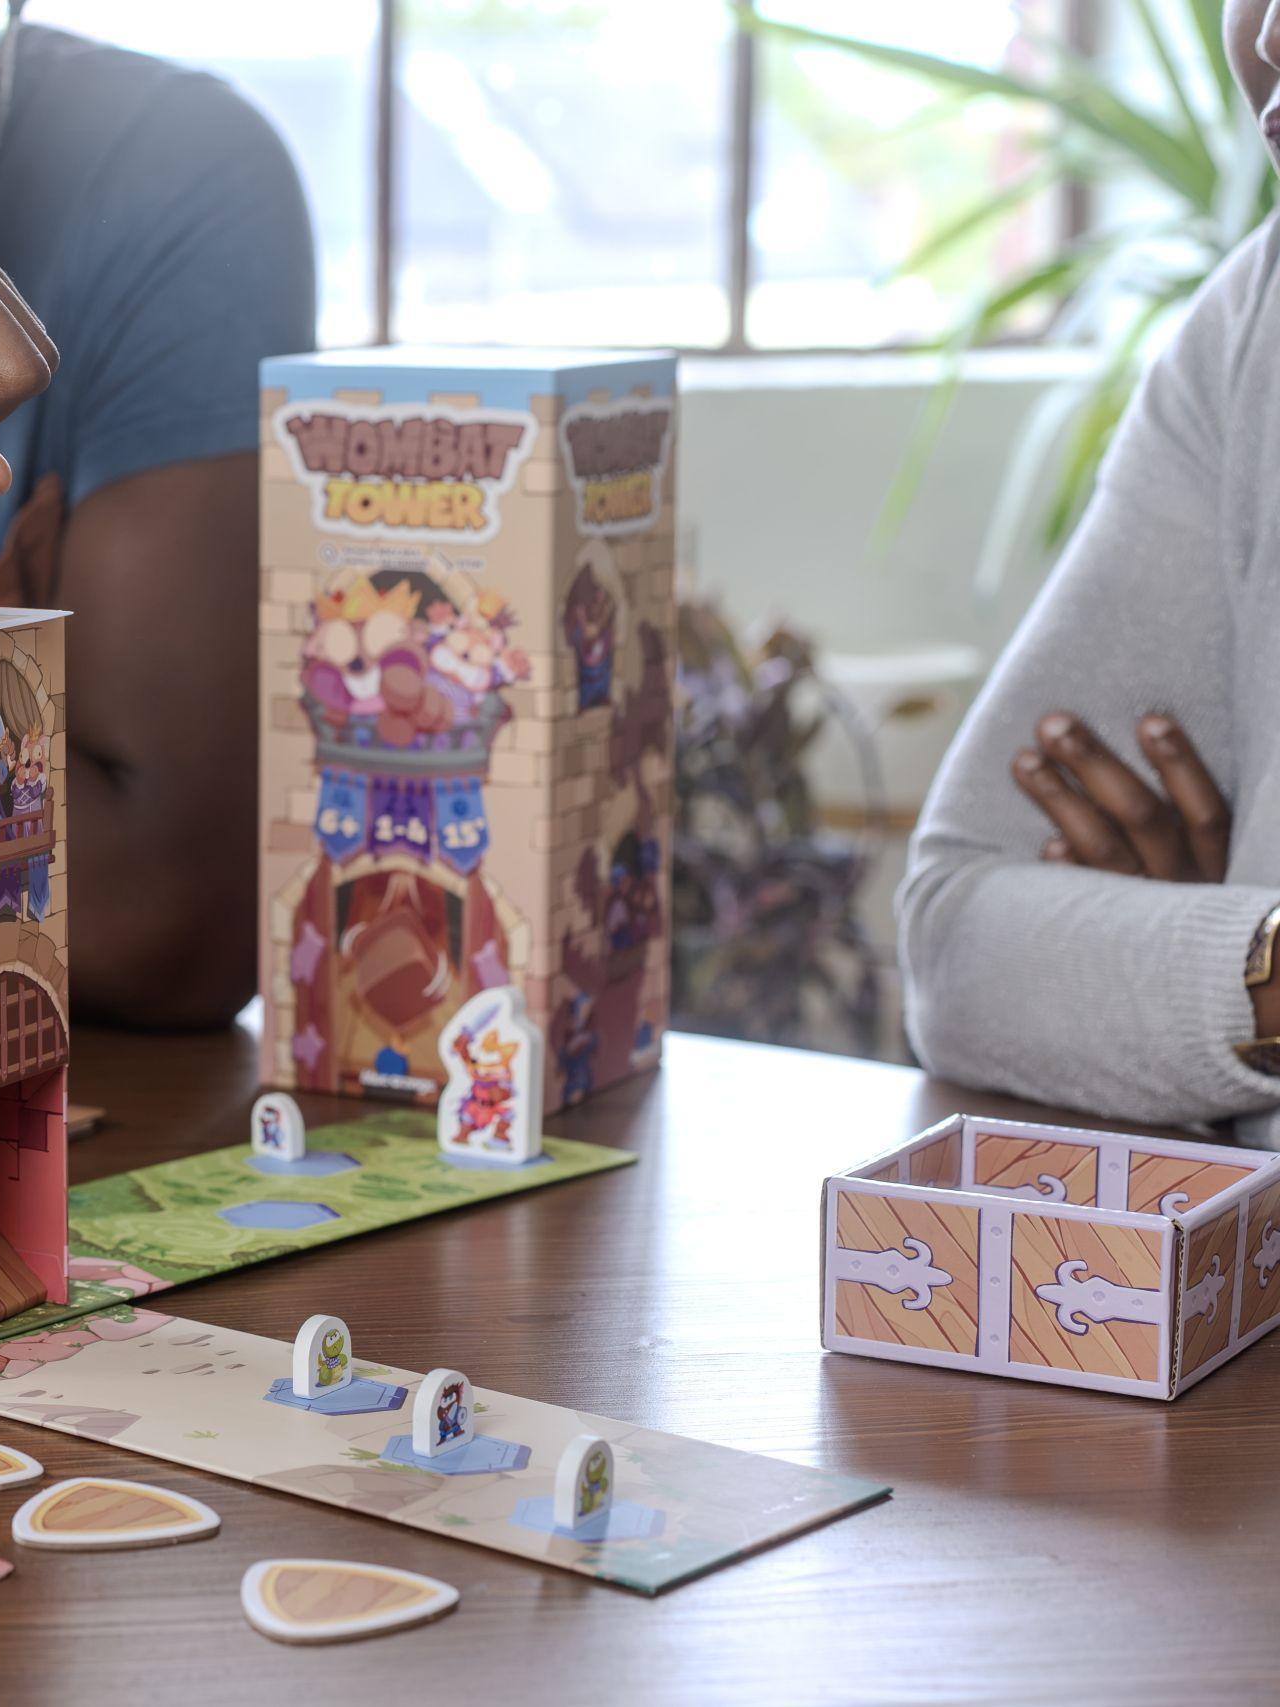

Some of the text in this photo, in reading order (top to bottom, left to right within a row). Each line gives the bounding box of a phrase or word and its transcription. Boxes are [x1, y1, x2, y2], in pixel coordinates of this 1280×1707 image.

[286, 414, 524, 481] WOMBAT
[326, 476, 487, 531] TOWER
[319, 808, 360, 839] 6+
